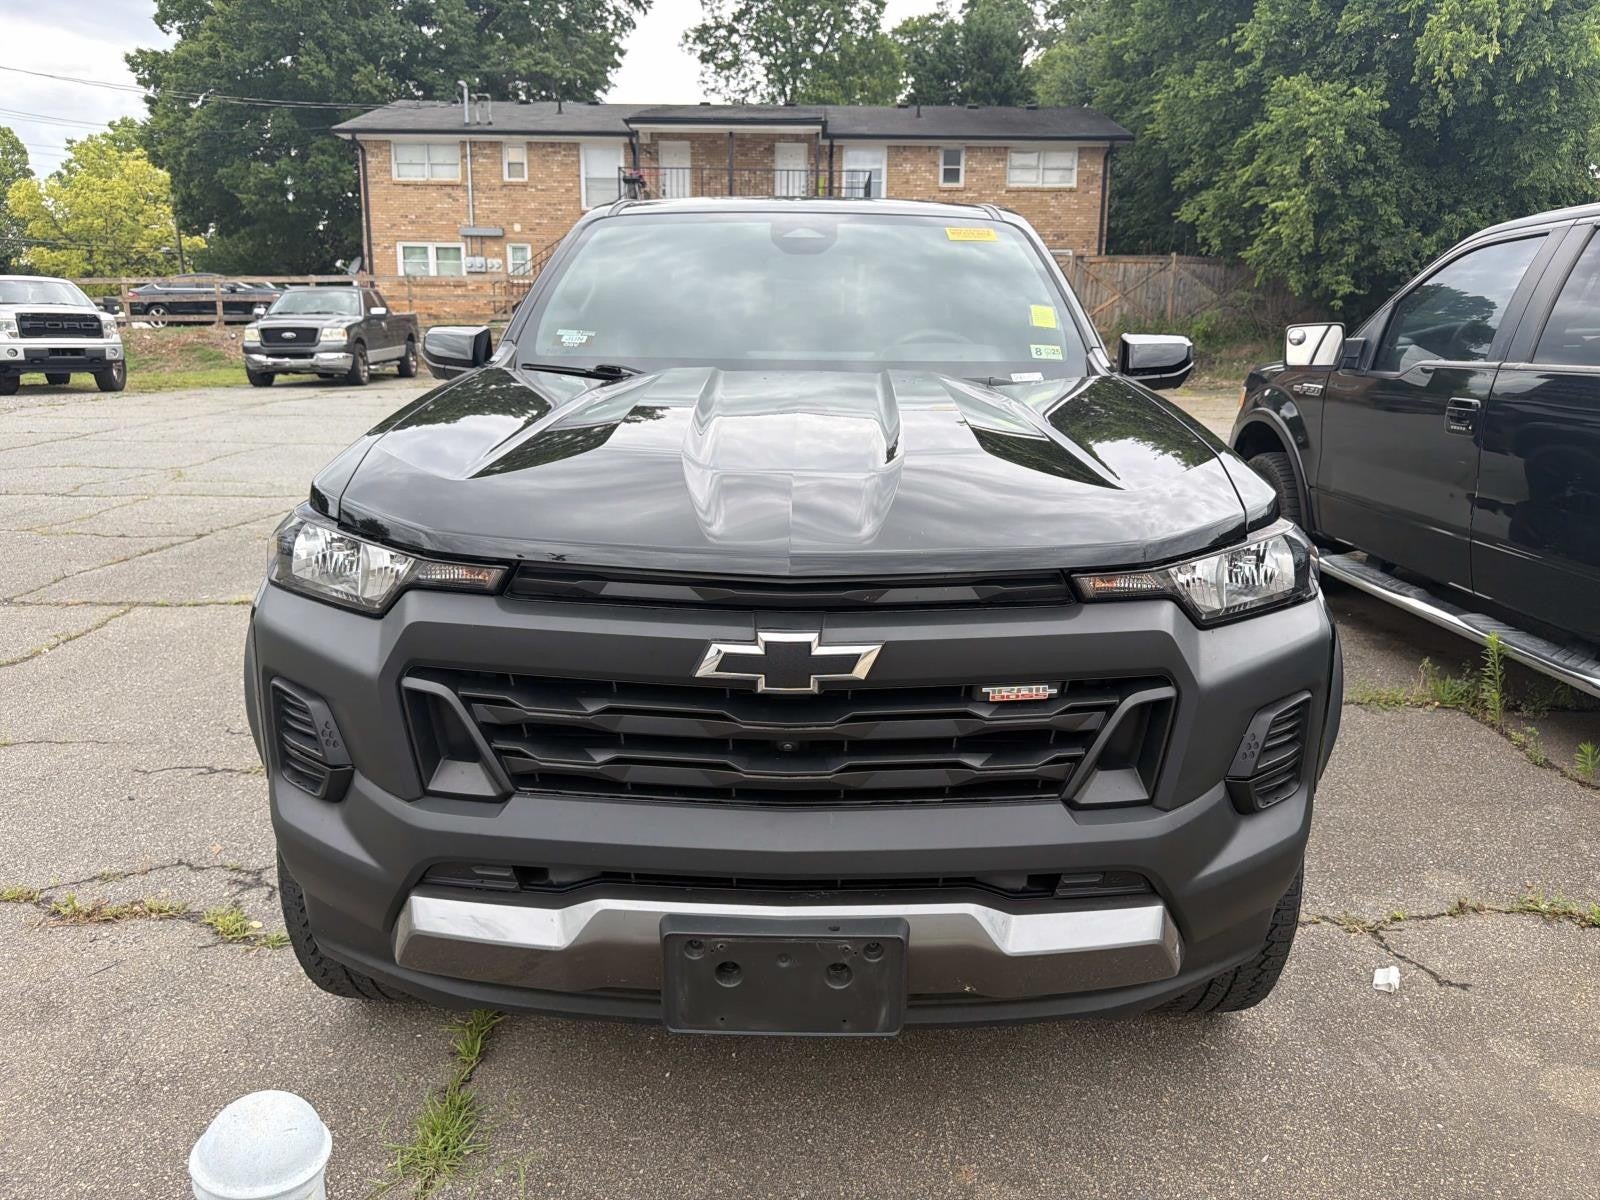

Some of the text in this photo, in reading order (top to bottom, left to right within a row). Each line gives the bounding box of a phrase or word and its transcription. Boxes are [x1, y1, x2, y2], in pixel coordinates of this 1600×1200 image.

[21, 321, 99, 329] FORD
[1034, 347, 1042, 356] 8
[982, 685, 1058, 695] TRAIL
[989, 693, 1048, 702] BOSS
